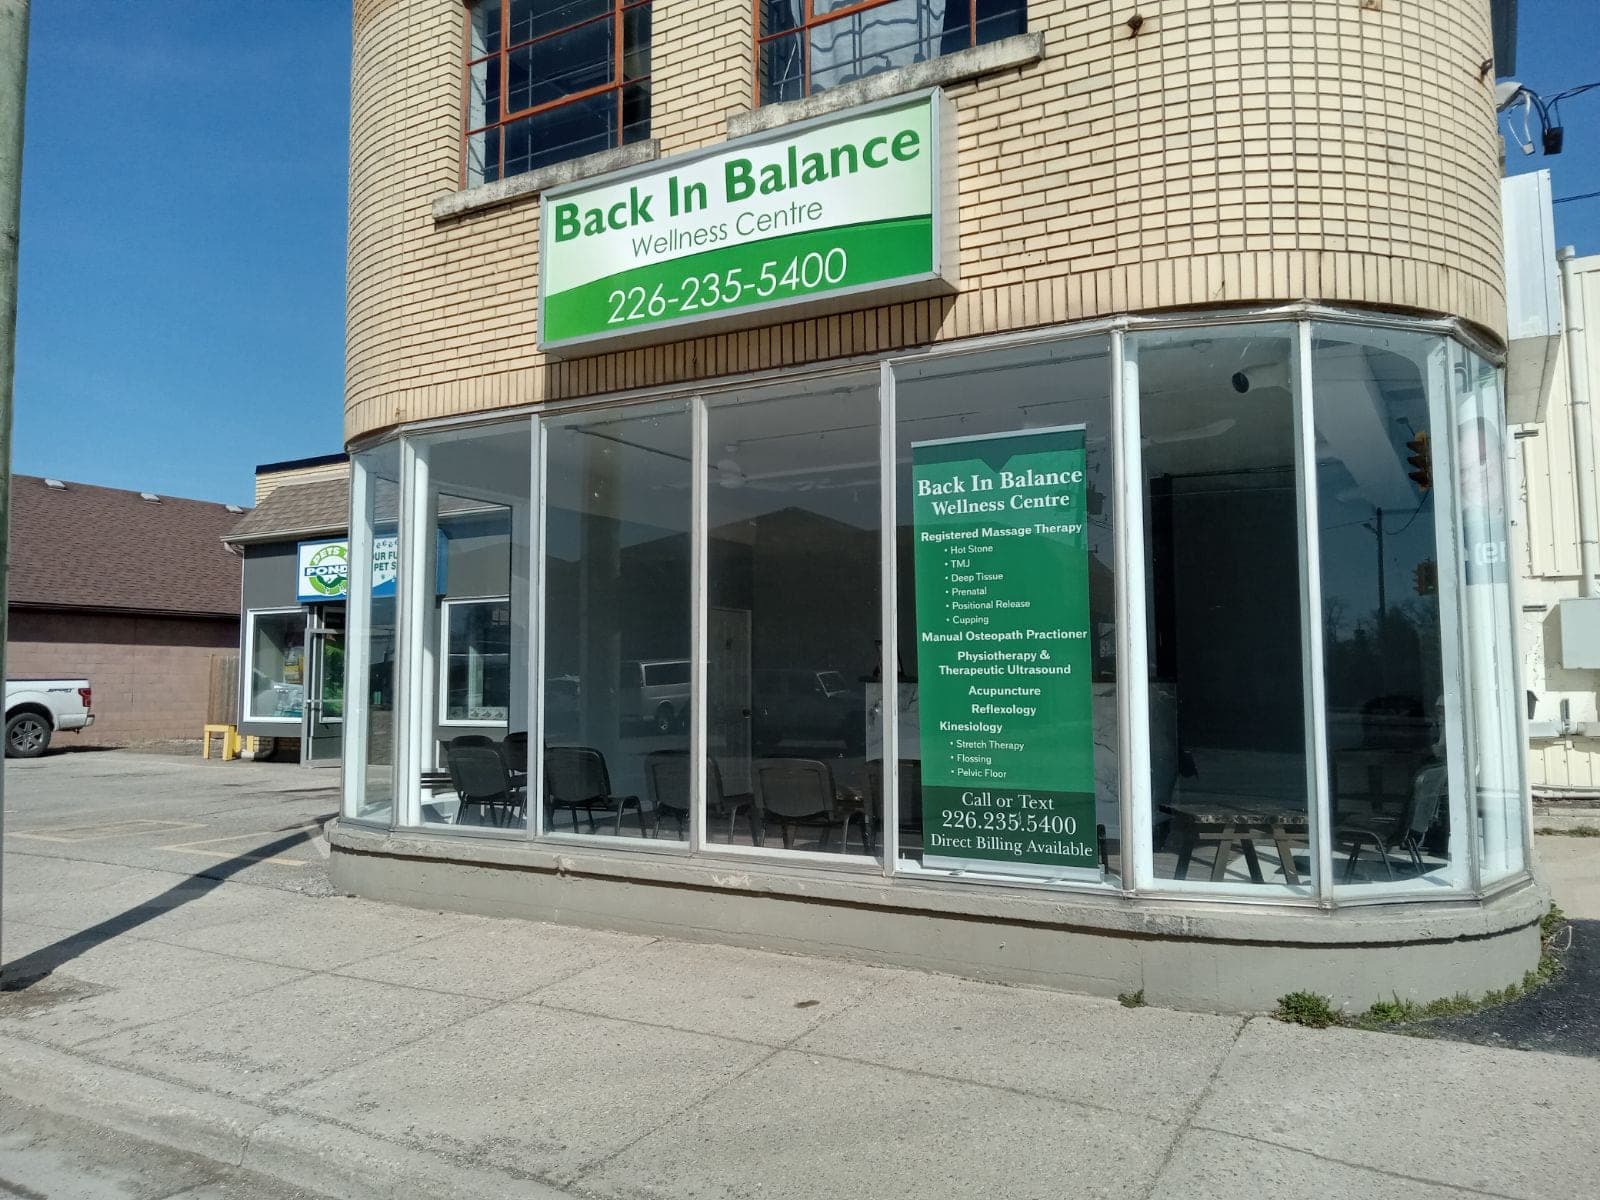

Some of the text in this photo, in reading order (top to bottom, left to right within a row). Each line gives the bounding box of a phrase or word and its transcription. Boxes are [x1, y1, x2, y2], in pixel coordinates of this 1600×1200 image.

[555, 129, 920, 243] Back In Balance
[633, 201, 822, 257] Wellness Centre
[608, 247, 847, 324] 226-235-5400
[918, 470, 1082, 496] Back In Balance
[932, 495, 1070, 515] Wellness Centre
[921, 524, 1082, 542] Registered Massage Therapy
[951, 545, 993, 554] Hot Stone
[314, 547, 341, 565] PETS
[374, 563, 389, 571] PET
[951, 560, 970, 568] TMJ
[952, 573, 1003, 582] Deep Tissue
[952, 587, 986, 595] Prenatal
[952, 600, 1030, 610] Positional Release
[953, 616, 989, 624] Cupping
[922, 630, 1087, 642] Manual Osteopath Practioner
[958, 650, 1050, 661] Physiotherapy &
[939, 665, 1070, 676] Therapeutic Ultrasound
[969, 687, 1040, 697] Acupuncture
[972, 705, 1036, 716] Reflexology
[940, 722, 1002, 733] Kinesiology
[956, 740, 1024, 750] Stretch Therapy
[957, 755, 991, 764] Flossing
[958, 769, 1006, 778] Pelvic Floor
[962, 792, 1054, 810] Call or Text
[942, 810, 1076, 834] 226.235.5400
[931, 834, 1092, 856] Direct Billing Available
